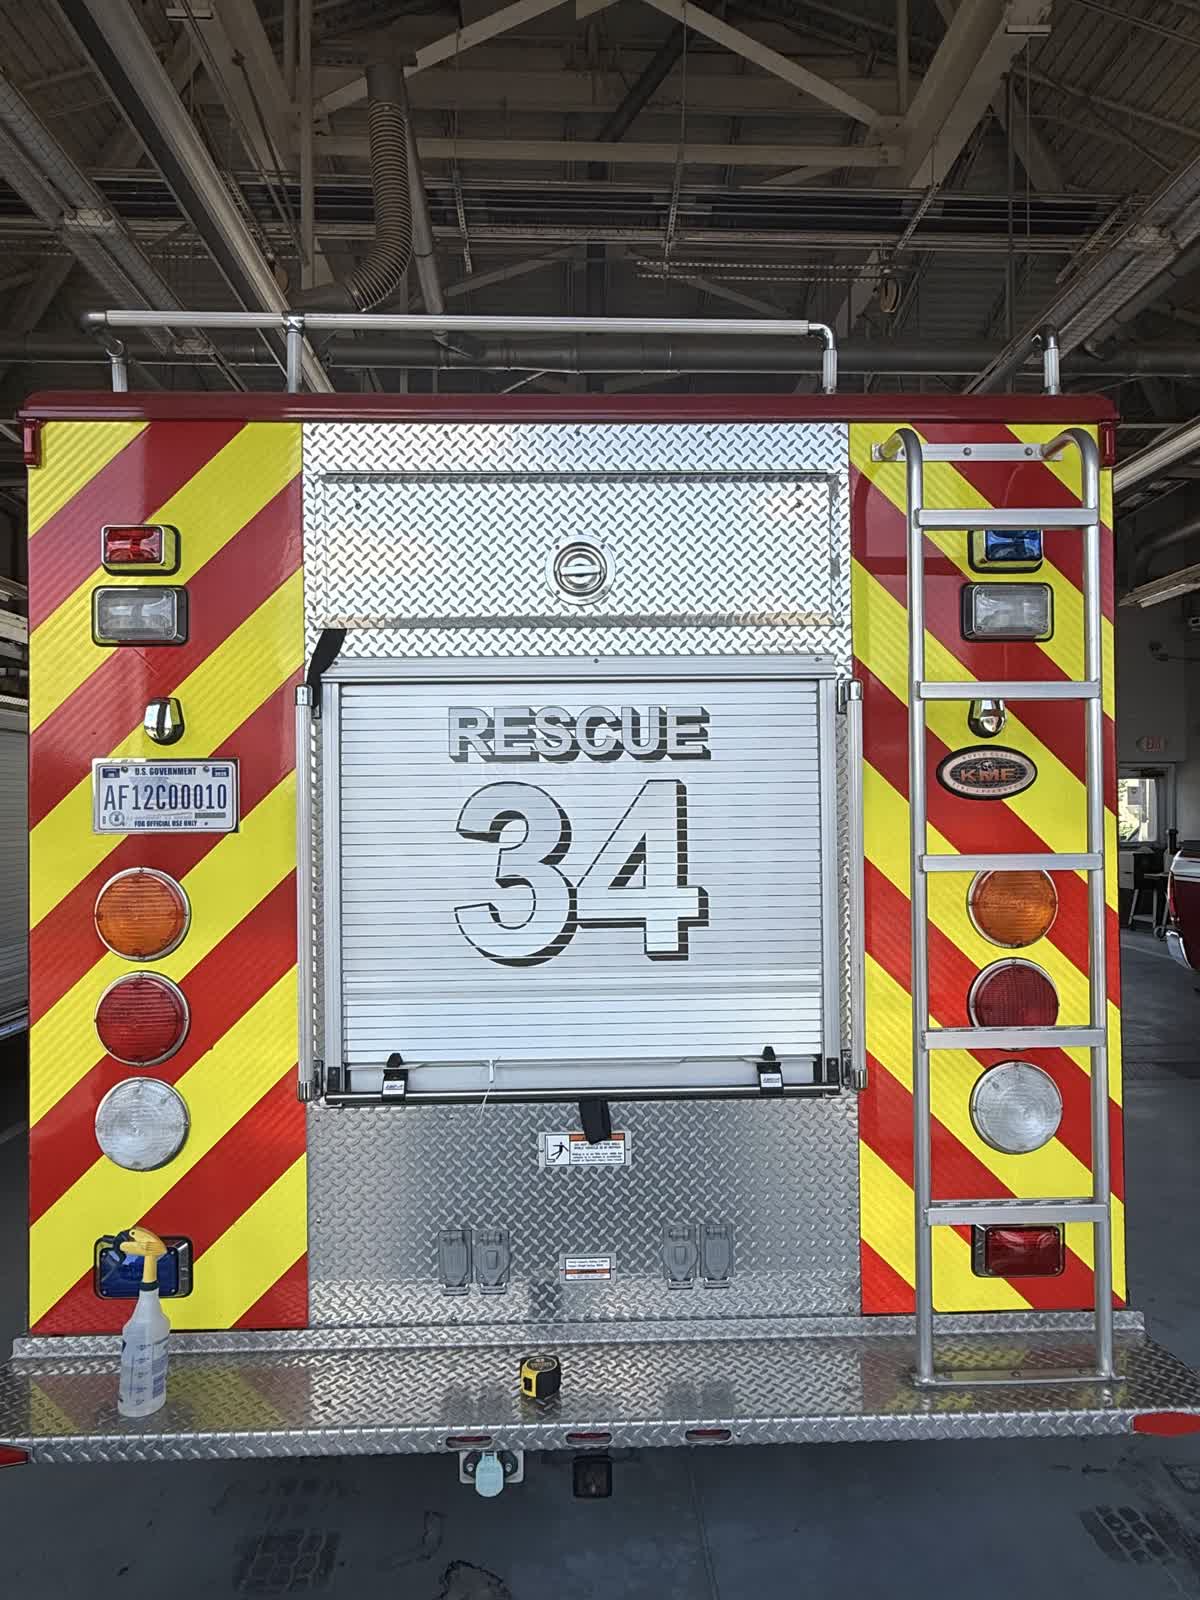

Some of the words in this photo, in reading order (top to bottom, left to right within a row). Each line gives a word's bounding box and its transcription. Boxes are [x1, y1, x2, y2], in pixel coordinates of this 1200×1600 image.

[448, 706, 711, 763] RESCUE
[135, 767, 148, 776] U.S.
[149, 767, 197, 776] GOVERNMENT
[960, 767, 1016, 782] KME
[103, 783, 227, 810] AF12C00010
[183, 819, 197, 827] ONLY
[454, 779, 709, 967] 34
